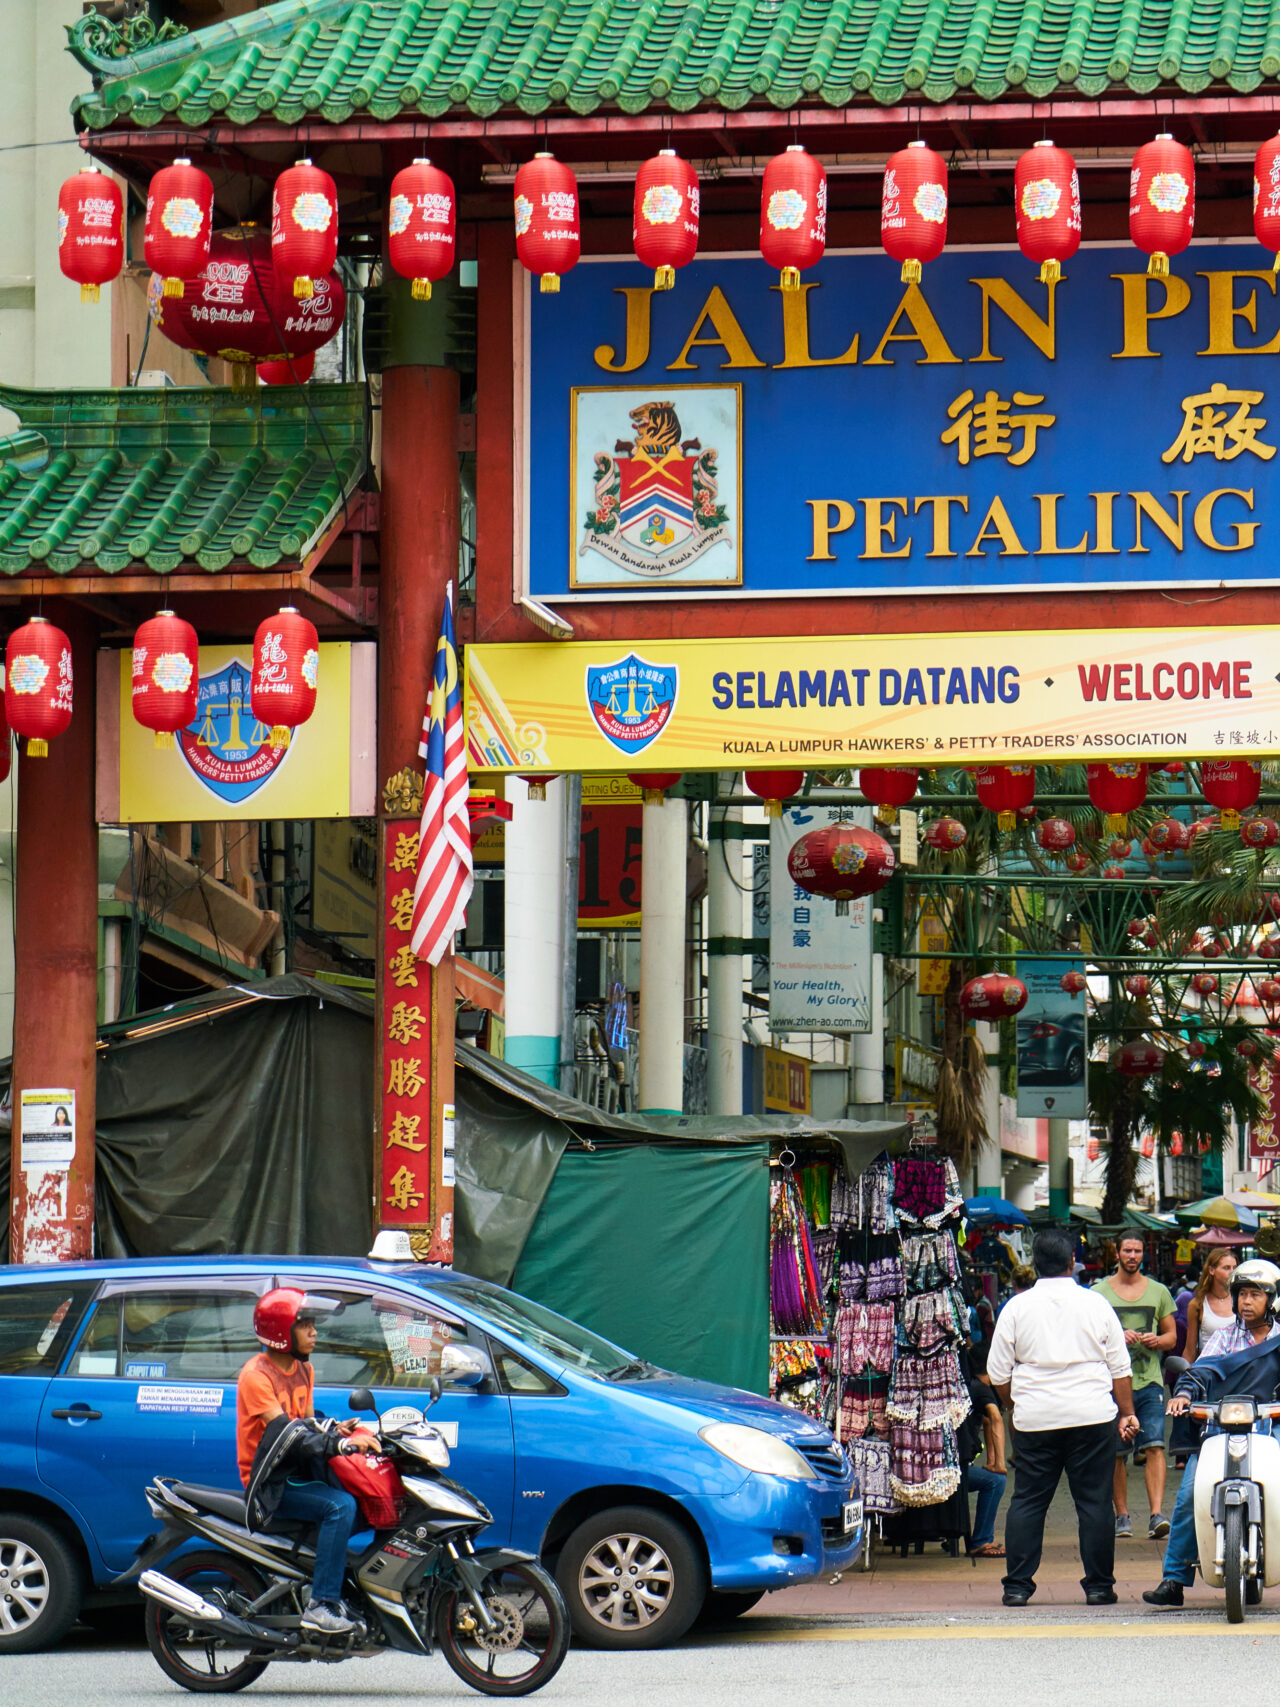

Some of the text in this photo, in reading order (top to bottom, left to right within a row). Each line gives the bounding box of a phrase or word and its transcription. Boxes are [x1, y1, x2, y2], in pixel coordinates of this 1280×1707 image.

[202, 282, 244, 303] KEE
[593, 275, 1069, 373] JALAN
[806, 487, 1262, 563] PETALING
[590, 528, 724, 574] Dewan Bandaraya Kuala Lumpur
[712, 664, 1021, 710] SELAMAT DATANG
[1077, 660, 1253, 703] WELCOME
[723, 742, 777, 754] KUALA
[779, 739, 843, 752] LUMPUR
[934, 737, 944, 750] &
[949, 736, 998, 749] PETTY
[1083, 733, 1187, 747] ASSOCIATION
[205, 753, 268, 772] KUALA LUMPUR
[225, 751, 248, 760] 1953
[220, 772, 243, 781] PETTY
[140, 1404, 171, 1412] DAPATKAN
[392, 1412, 416, 1420] TEKSI
